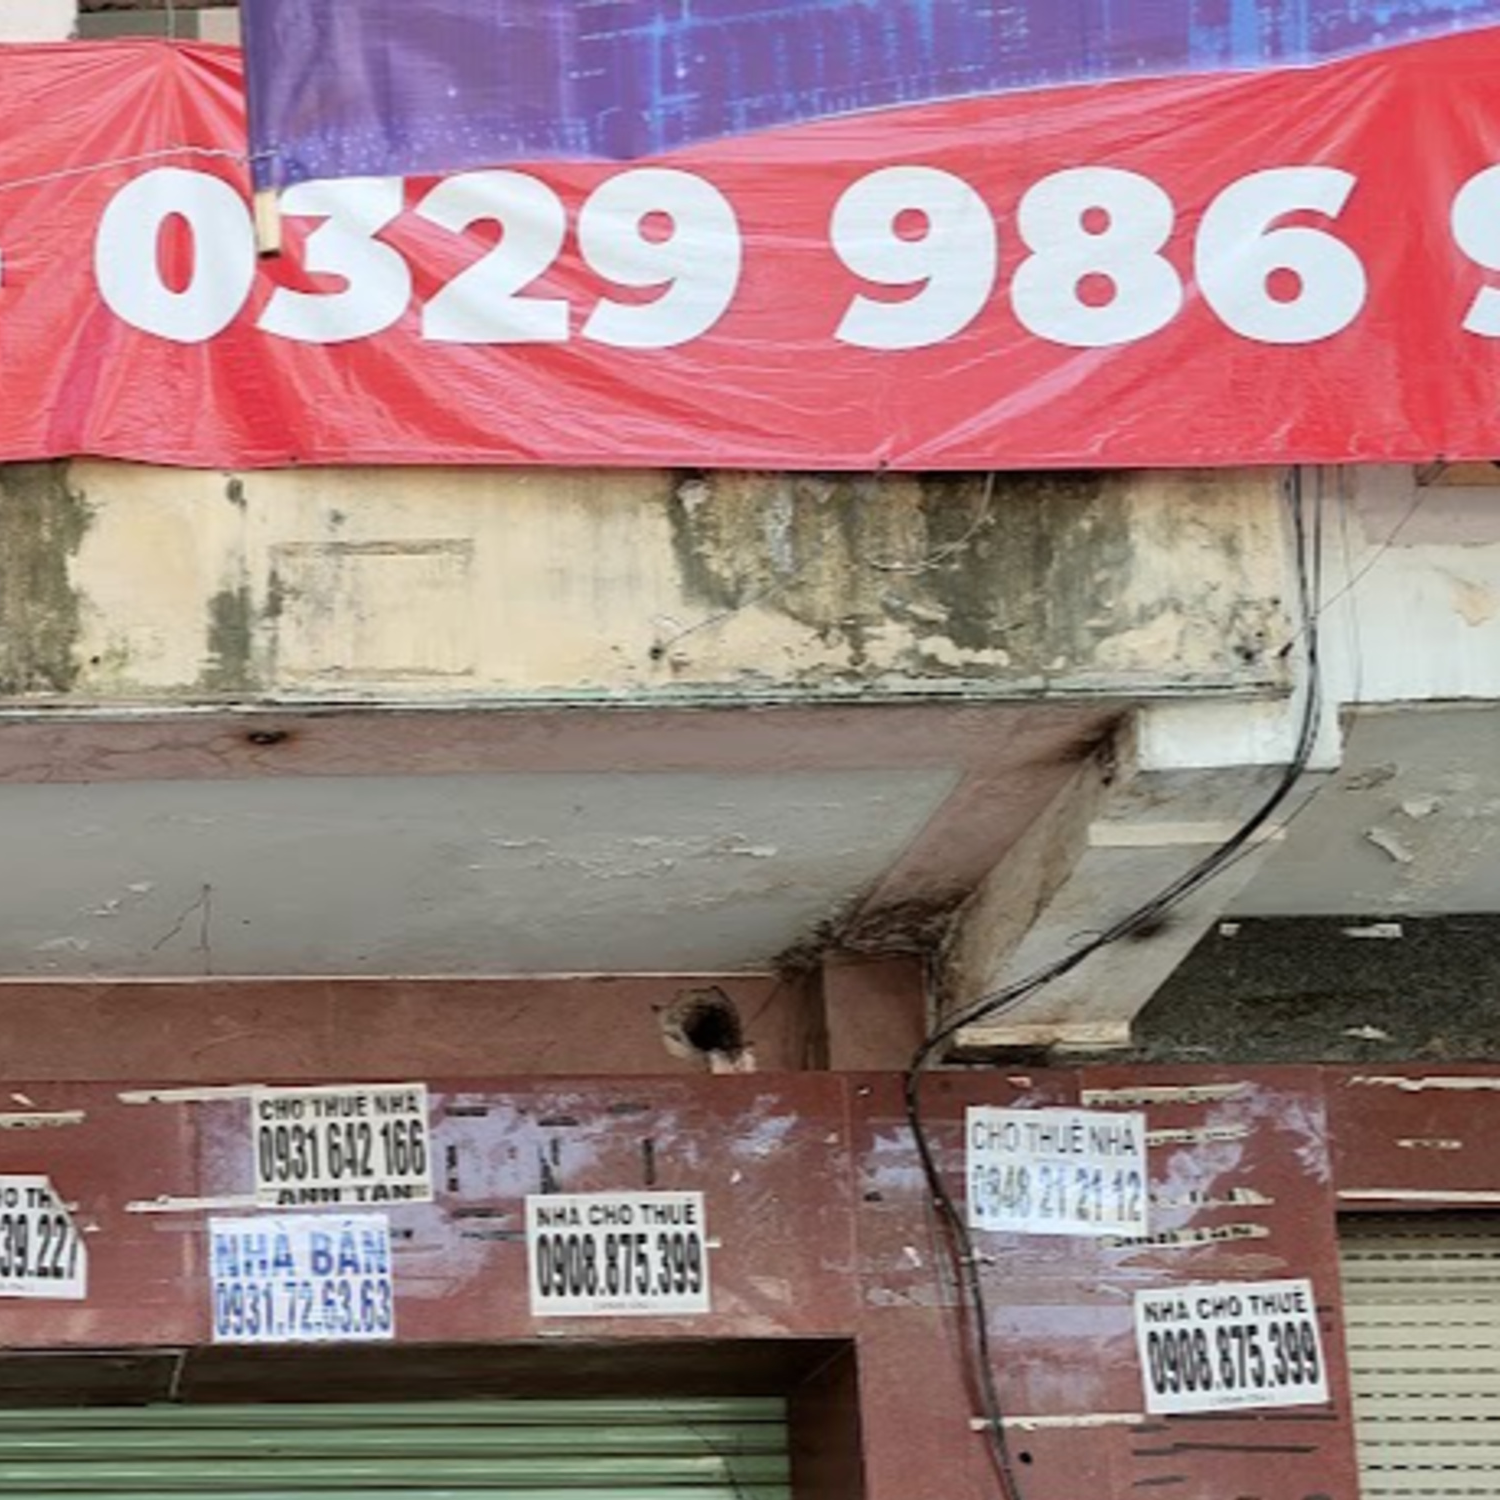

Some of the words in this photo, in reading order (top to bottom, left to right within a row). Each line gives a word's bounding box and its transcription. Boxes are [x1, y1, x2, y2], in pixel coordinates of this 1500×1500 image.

[93, 166, 742, 348] 0329
[829, 165, 1367, 348] 986
[259, 1124, 319, 1183] 0931
[380, 1118, 427, 1177] 166
[588, 1203, 634, 1226] CHO
[638, 1198, 698, 1226] THUÊ
[214, 1220, 295, 1278] NHÀ
[309, 1219, 388, 1277] BÁN
[1196, 1294, 1243, 1320] CHO
[1246, 1286, 1308, 1316] THUÊ
